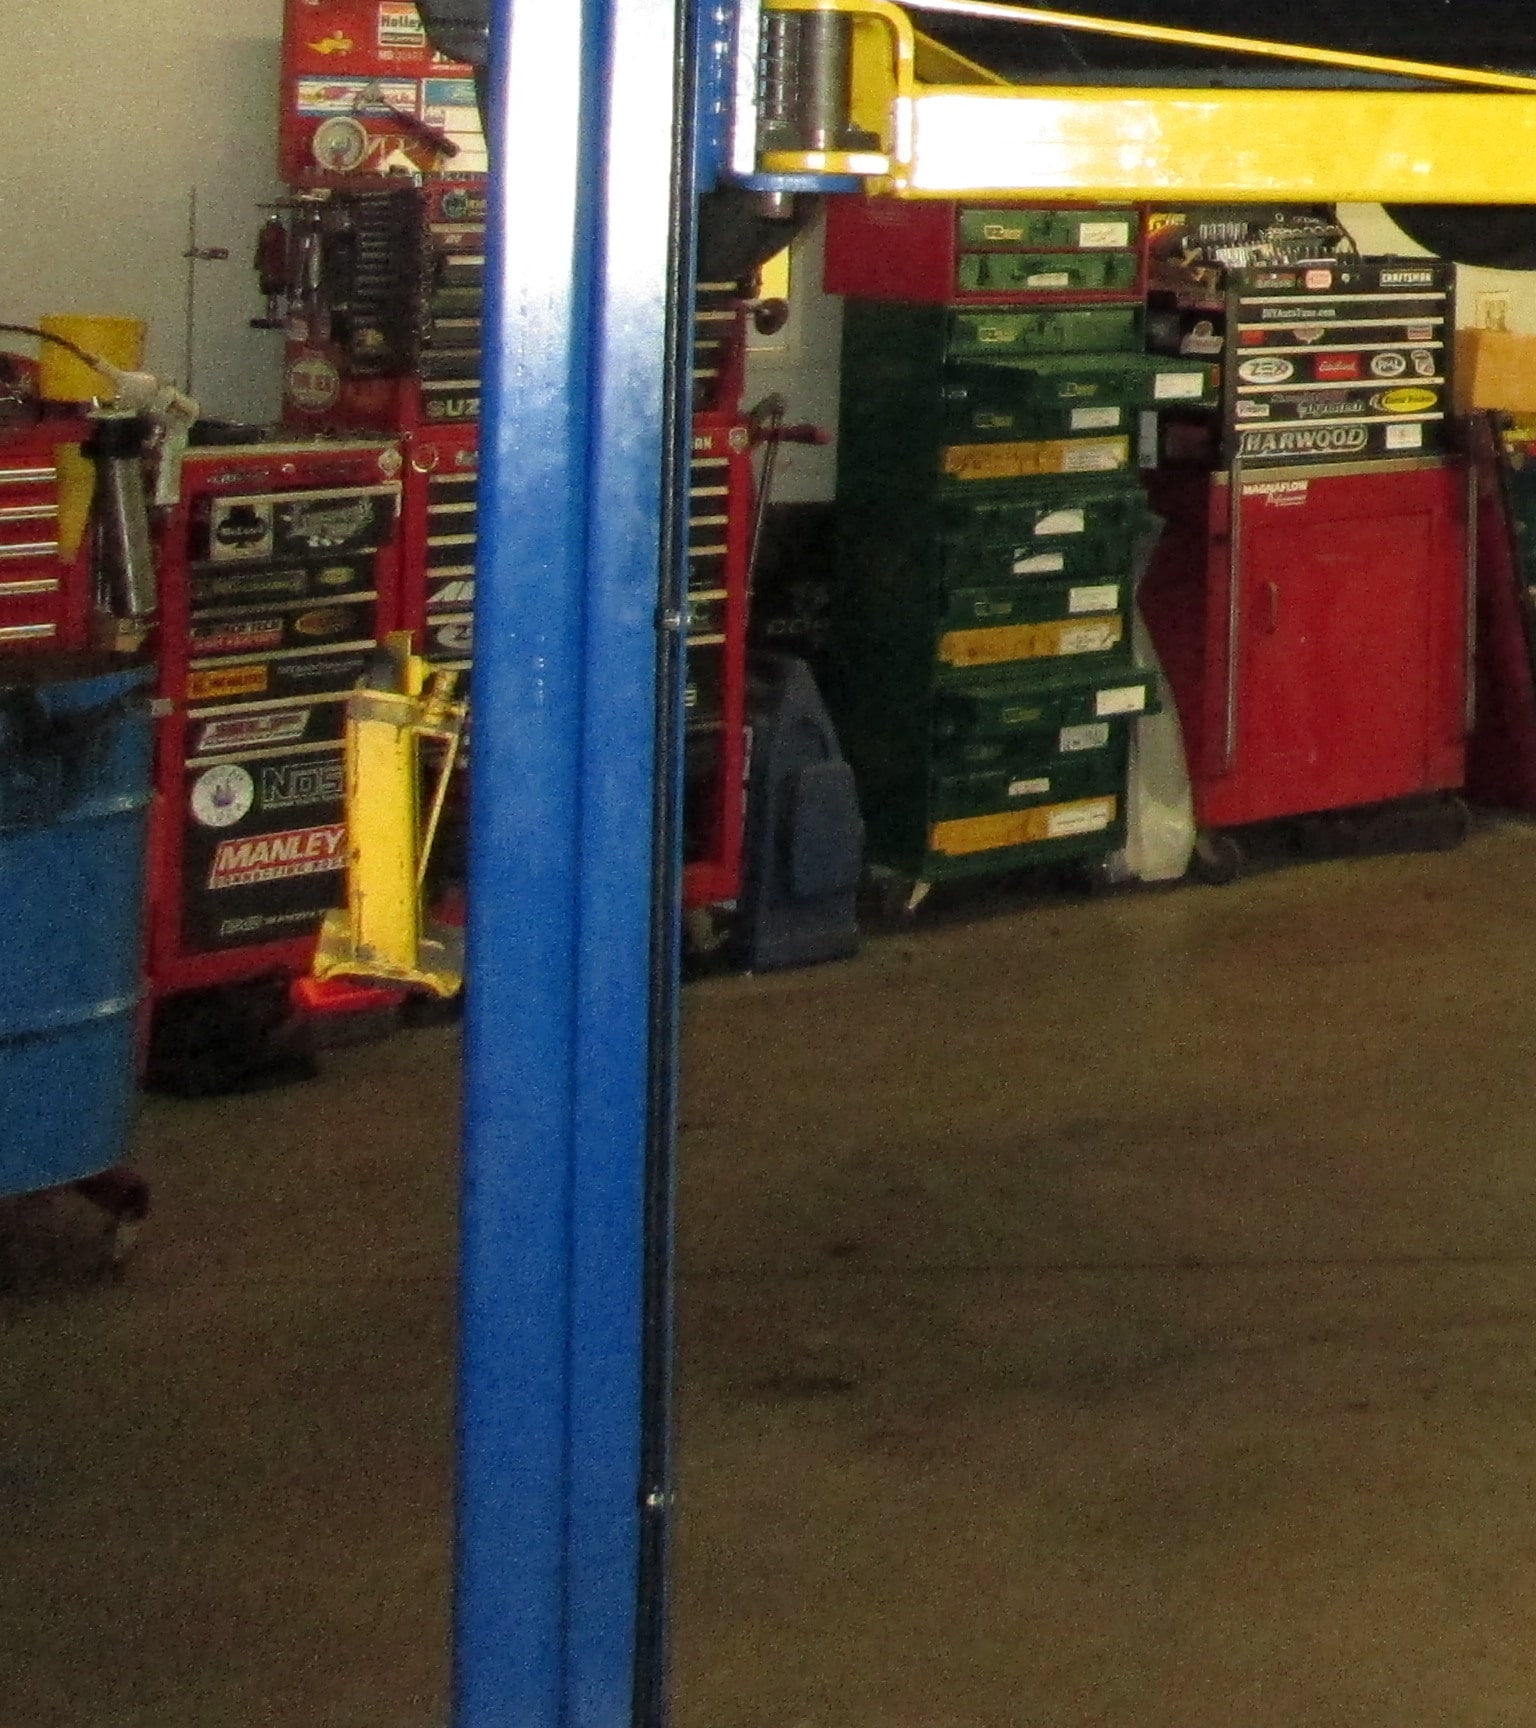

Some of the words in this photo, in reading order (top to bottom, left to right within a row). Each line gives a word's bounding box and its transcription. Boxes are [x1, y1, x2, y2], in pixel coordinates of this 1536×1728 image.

[381, 14, 423, 32] Holley
[1381, 271, 1432, 283] CRAFTSMAN
[1250, 361, 1289, 375] ZEX
[427, 398, 481, 419] SUZ
[1246, 427, 1366, 452] HARWOOD
[219, 828, 346, 872] MANLEY
